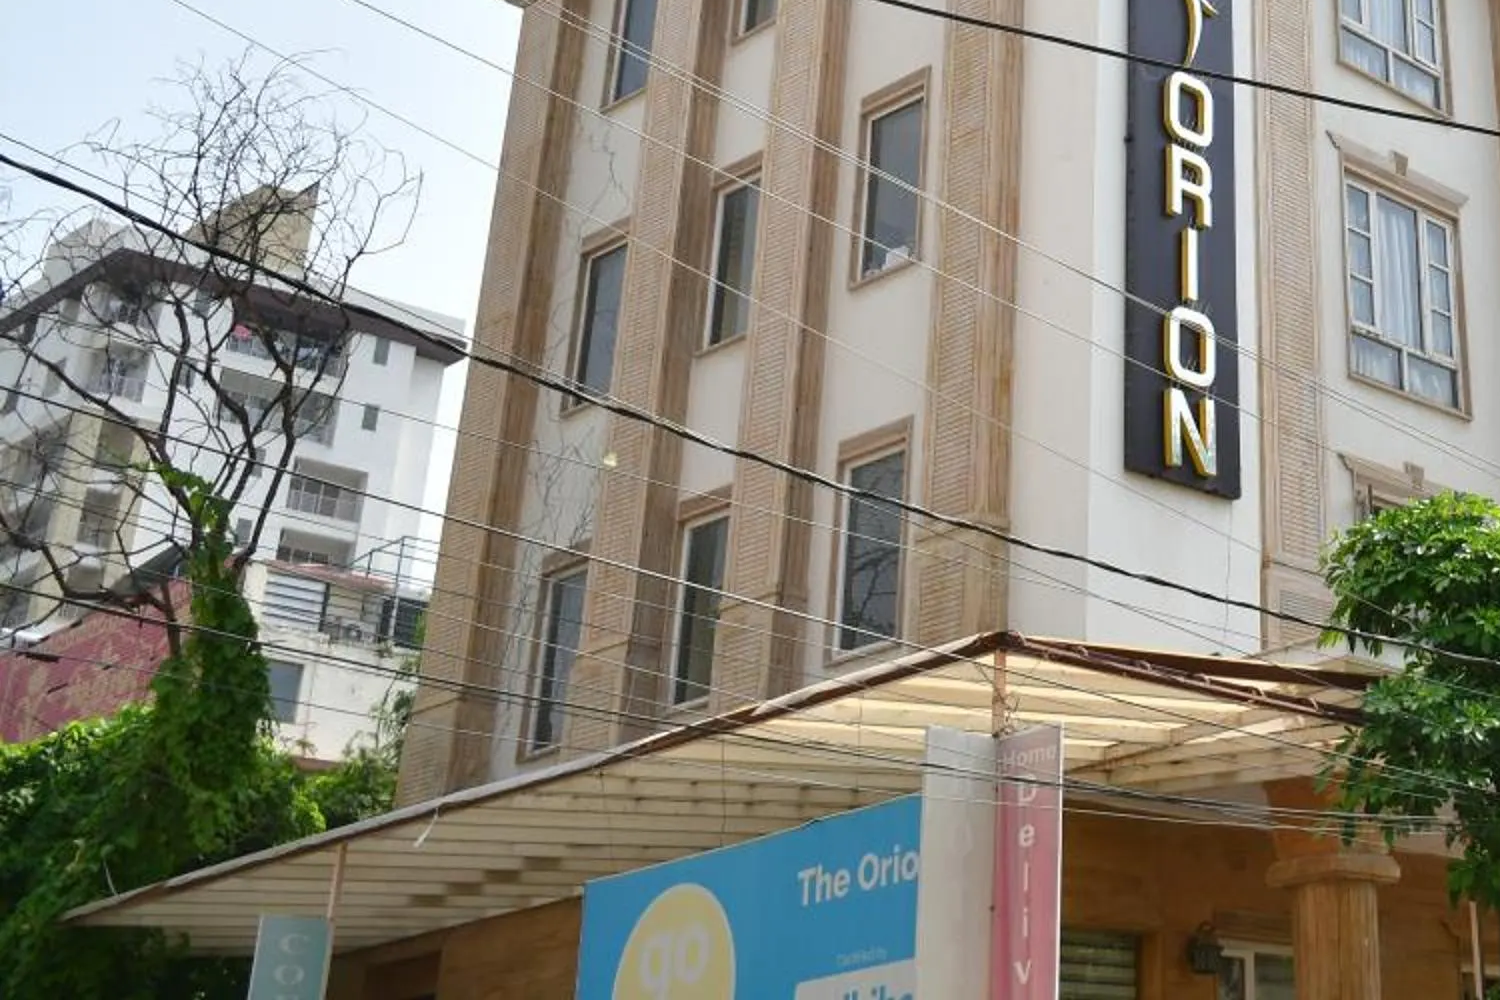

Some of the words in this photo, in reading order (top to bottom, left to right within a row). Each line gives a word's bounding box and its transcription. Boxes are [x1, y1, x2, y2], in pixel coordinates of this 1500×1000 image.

[1163, 70, 1217, 477] ORION
[798, 862, 850, 907] The
[639, 922, 709, 1000] go
